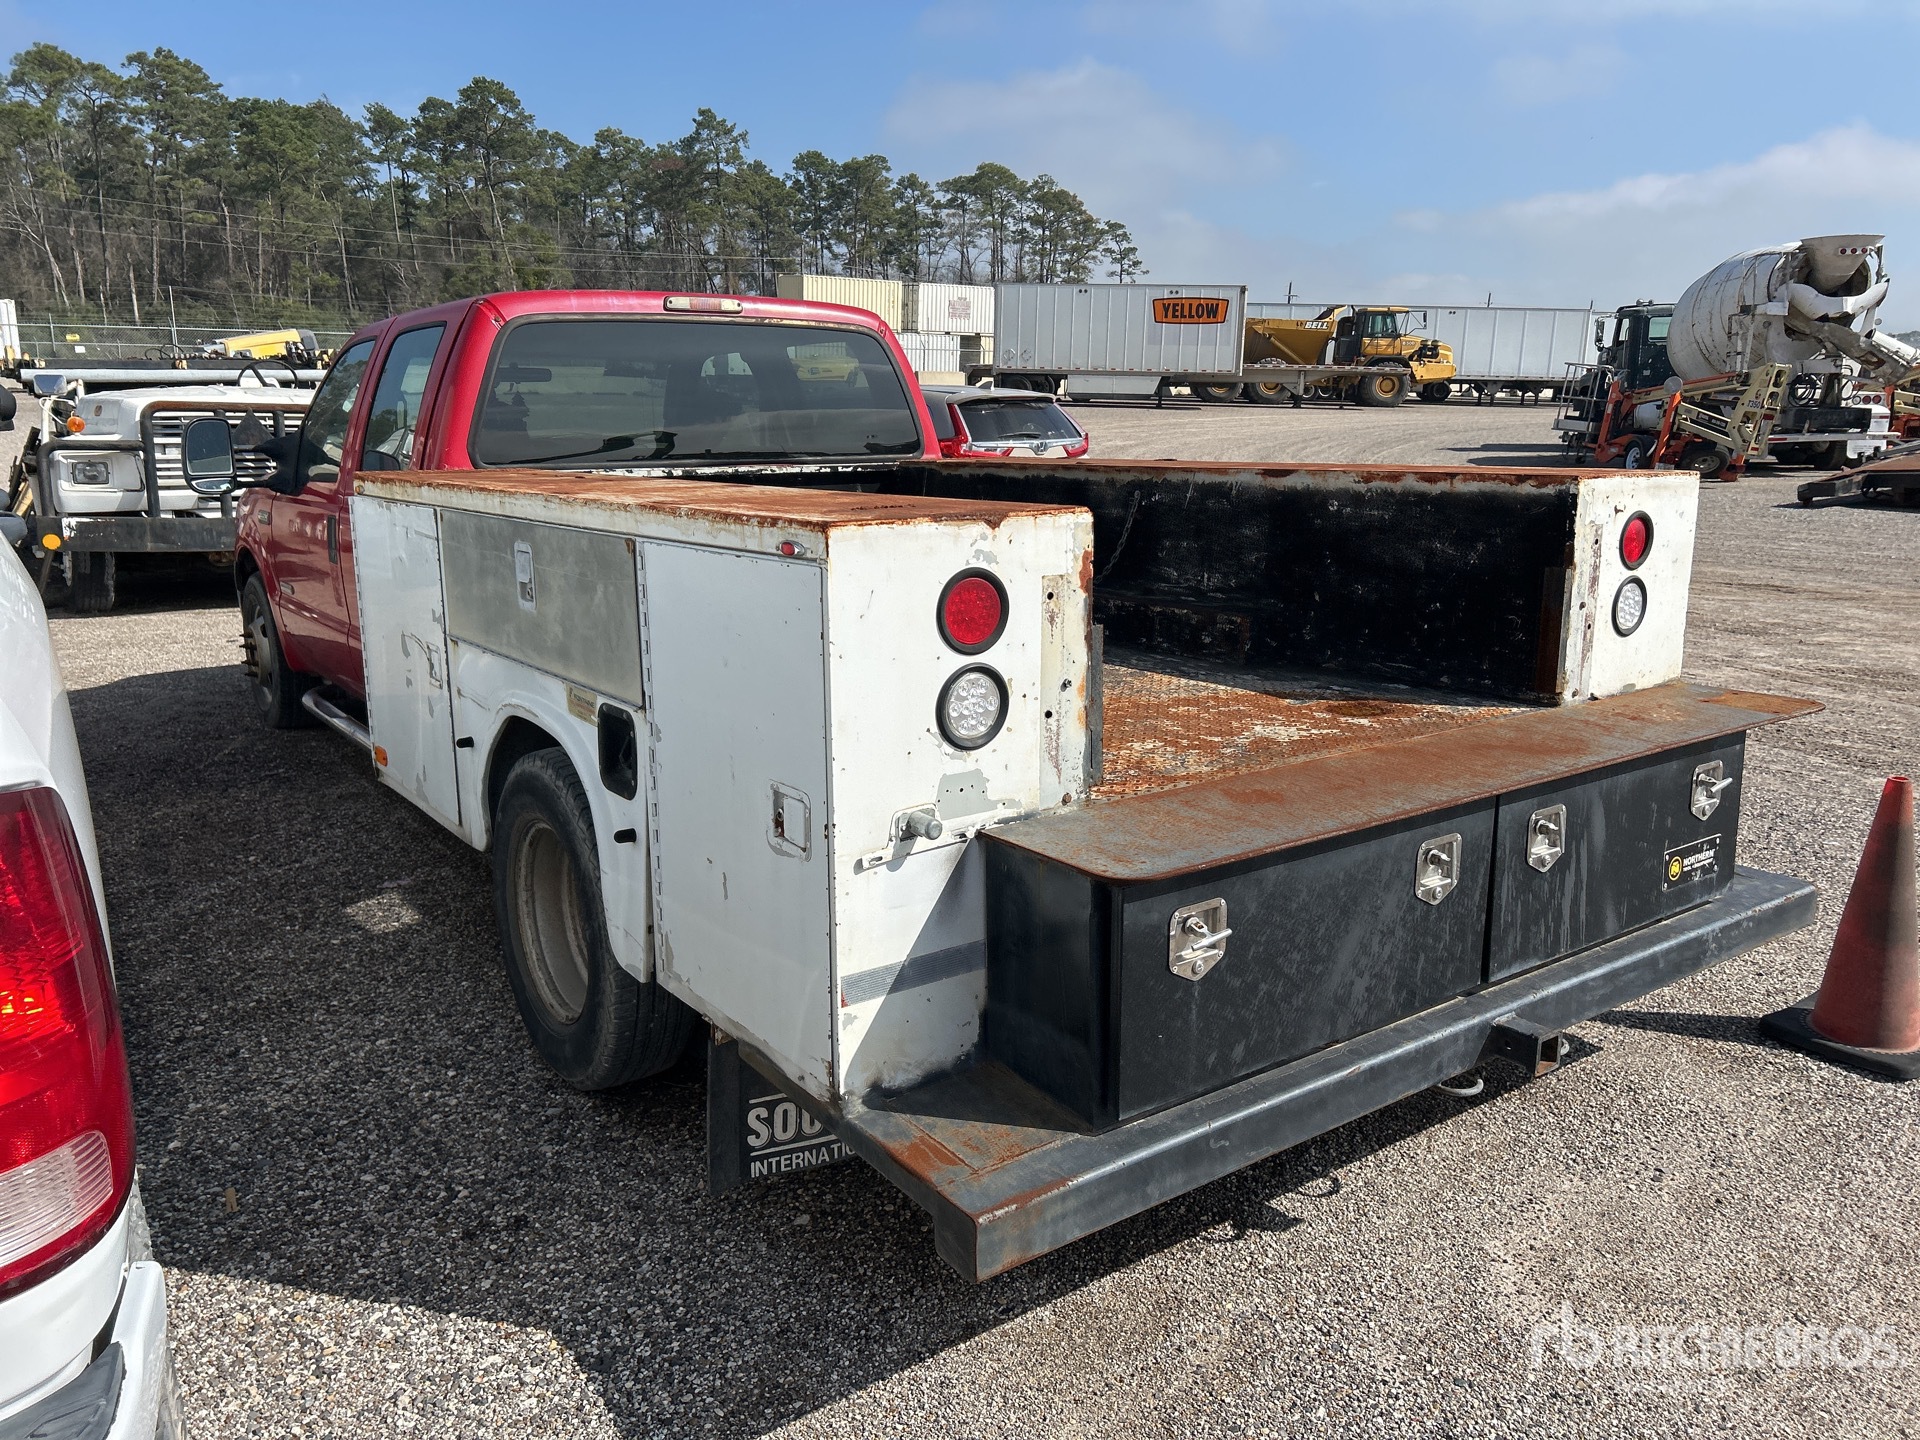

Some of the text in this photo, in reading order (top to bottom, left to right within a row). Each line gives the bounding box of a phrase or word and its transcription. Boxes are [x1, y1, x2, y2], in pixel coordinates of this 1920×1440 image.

[1162, 303, 1219, 319] YELLOW
[1304, 321, 1328, 329] BELL
[1683, 849, 1715, 867] NORTHERN
